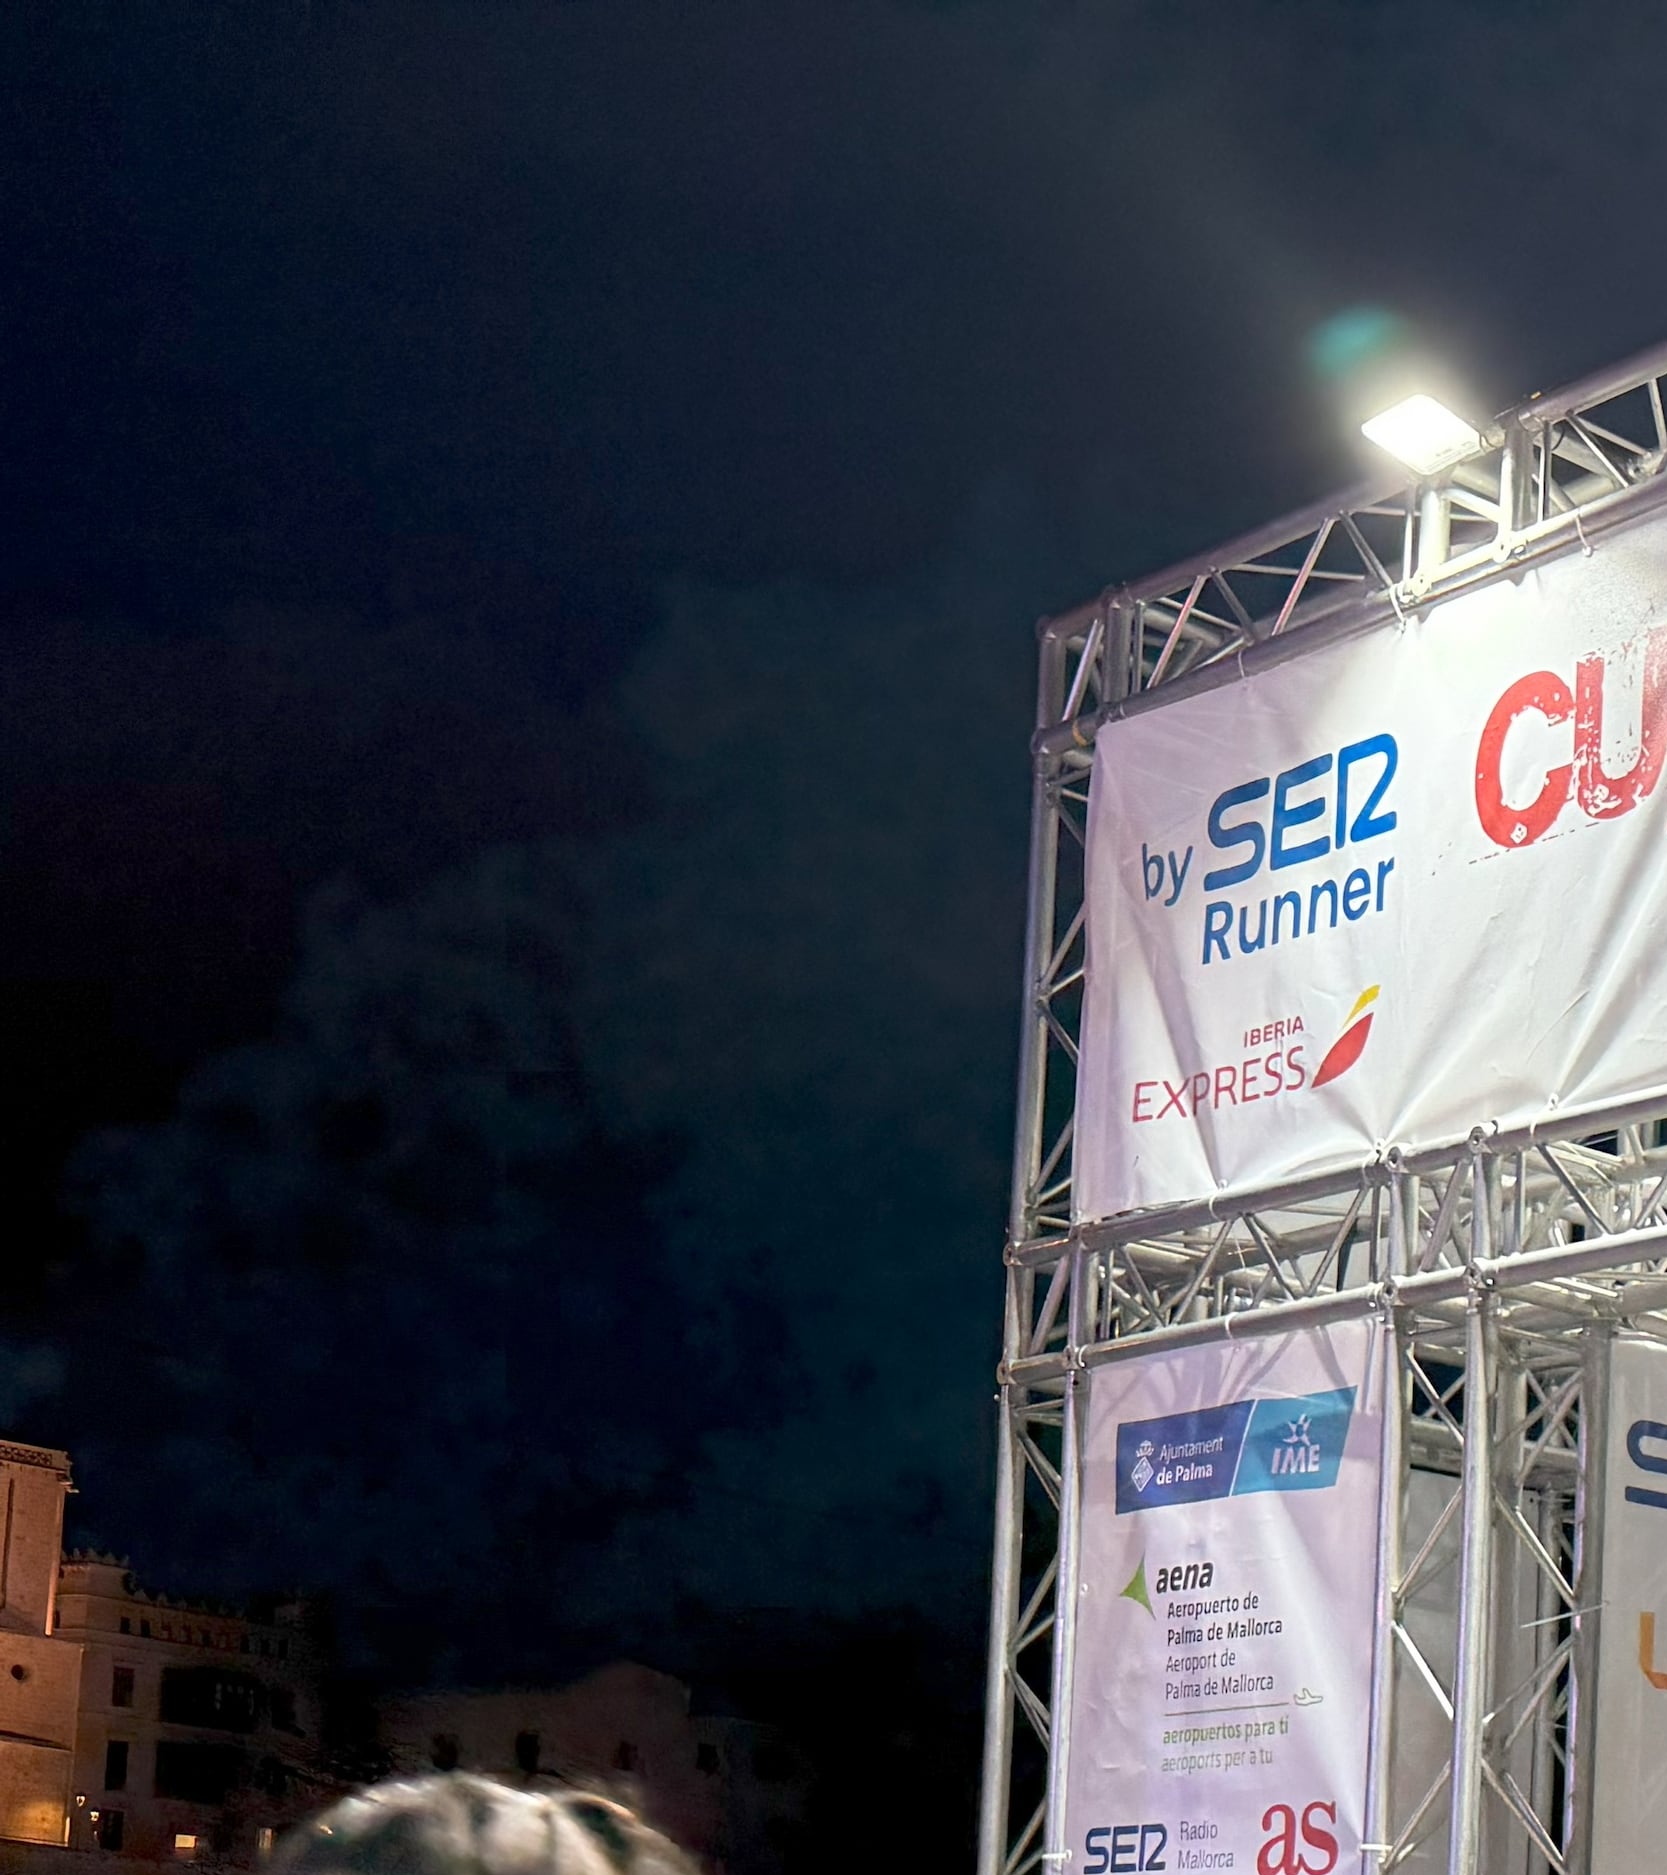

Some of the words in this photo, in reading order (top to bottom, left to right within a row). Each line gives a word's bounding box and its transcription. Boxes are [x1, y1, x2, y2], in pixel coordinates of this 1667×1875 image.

[1142, 841, 1194, 907] by
[1204, 733, 1398, 892] SER
[1201, 856, 1395, 965] Runner
[1243, 1016, 1305, 1050] IBERIA
[1132, 1048, 1306, 1123] EXPRESS
[1159, 1436, 1225, 1464] Ajuntament
[1271, 1444, 1321, 1475] IME
[1156, 1466, 1172, 1486] de
[1175, 1463, 1213, 1483] Palma
[1156, 1561, 1215, 1594] aena
[1167, 1596, 1240, 1620] Aeropuerto
[1243, 1591, 1259, 1610] de
[1167, 1627, 1203, 1647] Palma
[1207, 1620, 1224, 1641] de
[1227, 1617, 1283, 1640] Mallorca
[1166, 1651, 1217, 1673] Aeroport
[1220, 1648, 1236, 1667] de
[1165, 1681, 1201, 1701] Palma
[1204, 1677, 1218, 1696] de
[1221, 1673, 1274, 1695] Mallorca
[1163, 1722, 1241, 1750] aeropuertos
[1245, 1719, 1275, 1746] para
[1161, 1752, 1222, 1776] aeroports
[1224, 1749, 1246, 1772] per
[1249, 1749, 1258, 1766] a
[1259, 1747, 1273, 1765] tu
[1179, 1820, 1218, 1842] Radio
[1083, 1823, 1168, 1875] SER
[1177, 1849, 1235, 1870] Mallorca
